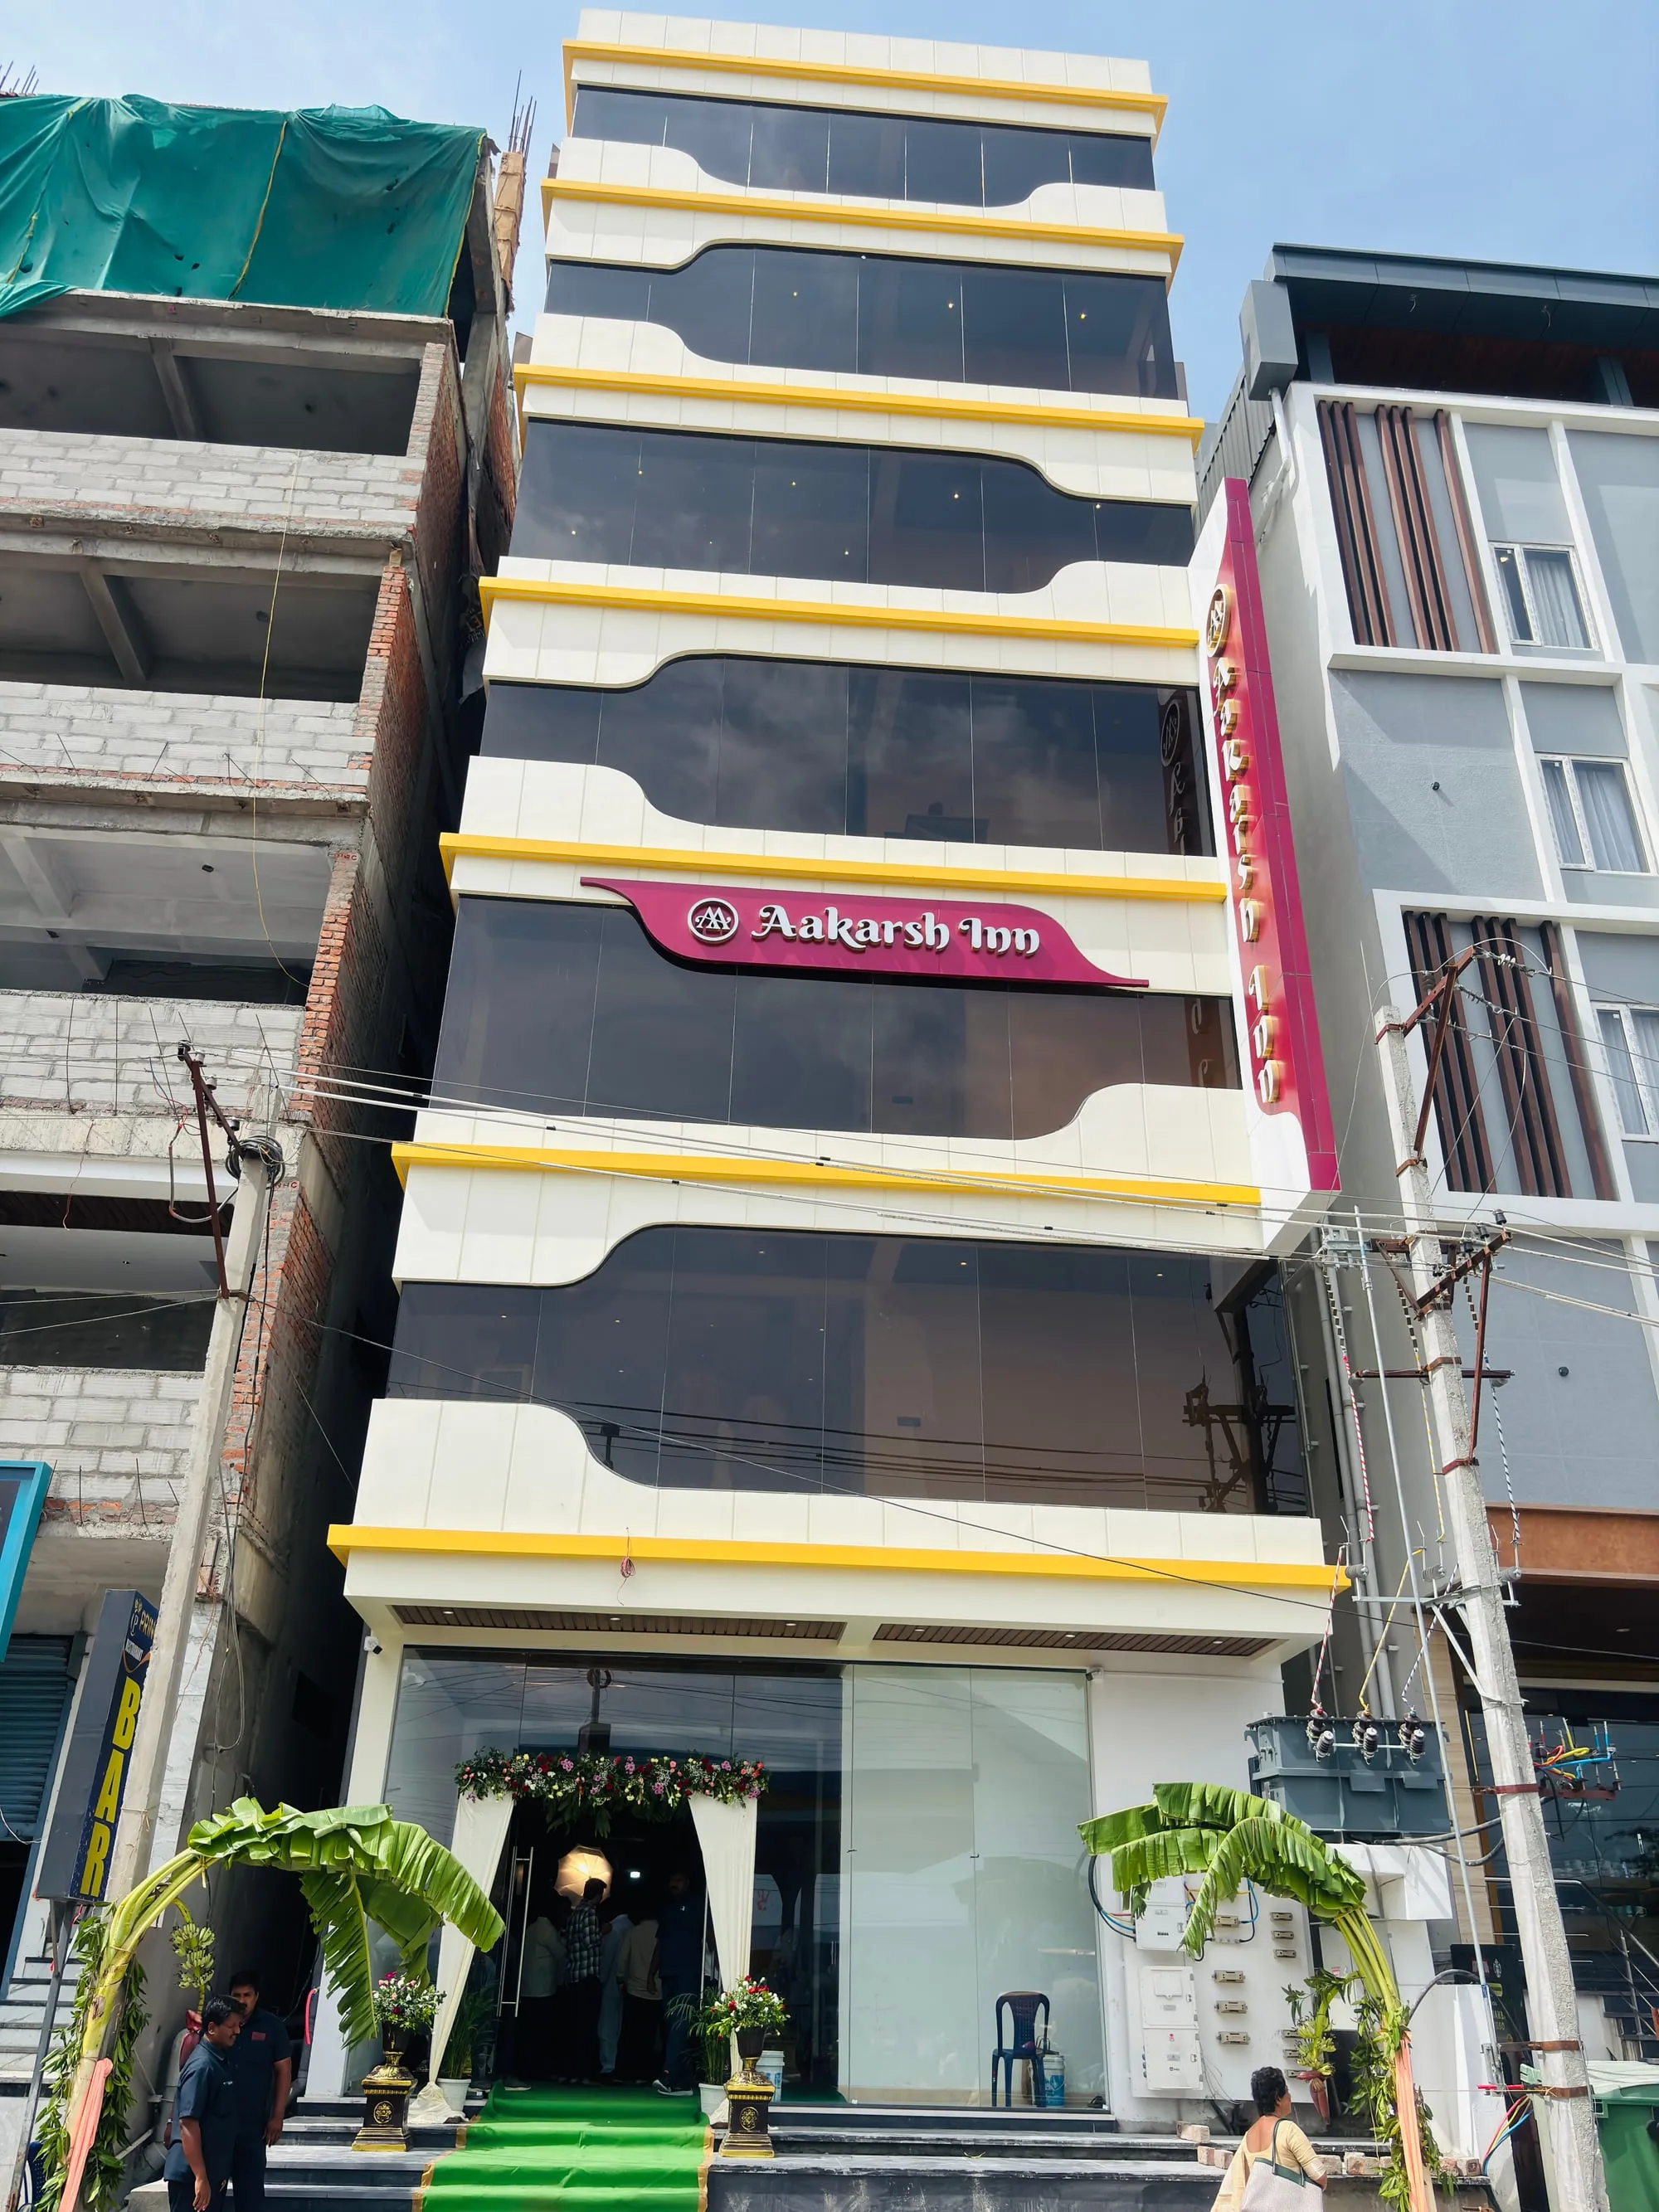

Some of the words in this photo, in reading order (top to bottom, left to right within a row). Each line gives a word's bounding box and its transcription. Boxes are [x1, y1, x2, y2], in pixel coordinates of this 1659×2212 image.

[751, 904, 950, 952] Aakarsh
[958, 917, 1040, 956] Inn
[1213, 658, 1260, 942] Aakarsh
[1248, 965, 1280, 1103] Inn
[80, 1676, 142, 1898] BAR
